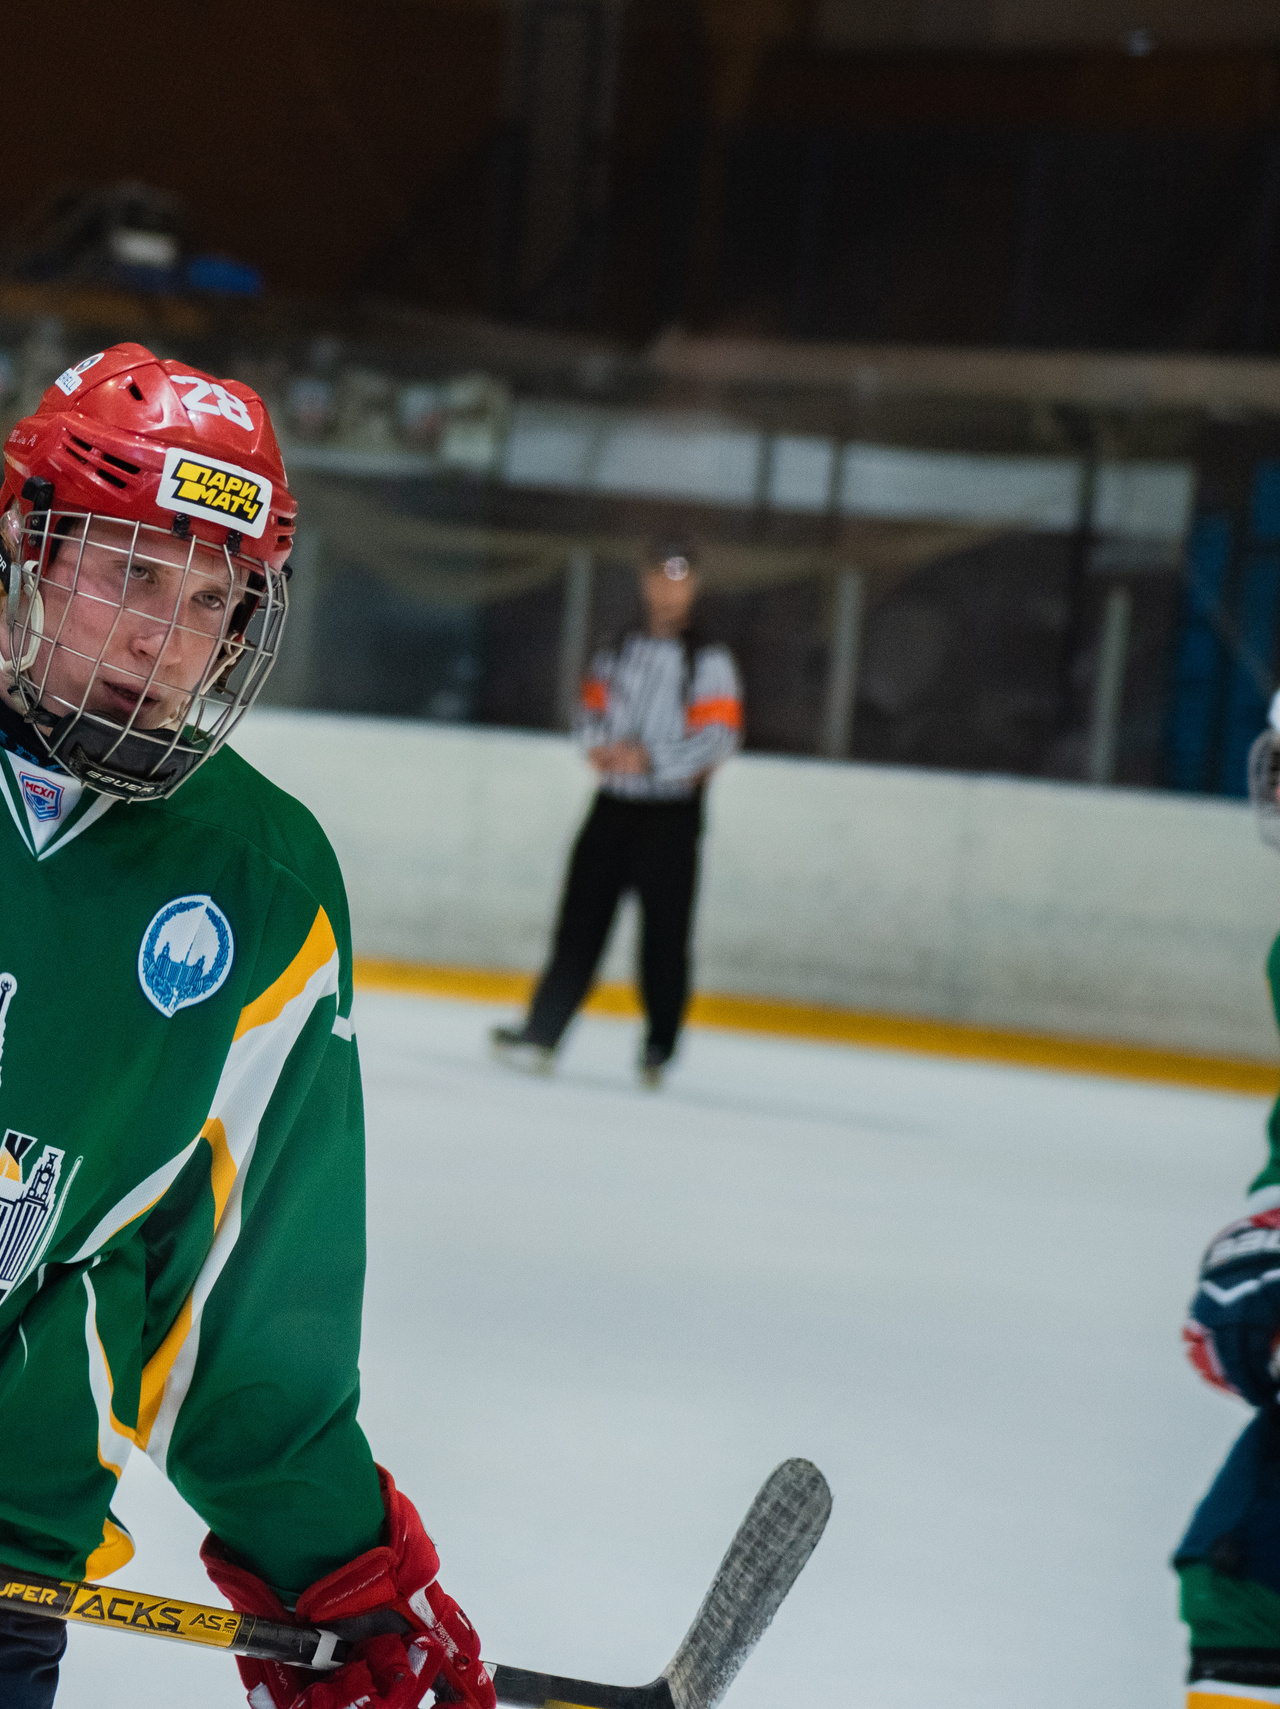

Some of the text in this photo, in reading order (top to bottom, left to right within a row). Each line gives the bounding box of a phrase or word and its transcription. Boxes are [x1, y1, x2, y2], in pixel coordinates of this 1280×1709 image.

[169, 374, 255, 432] 28
[176, 461, 259, 501] ПАРИ
[177, 480, 260, 520] МАТЧ
